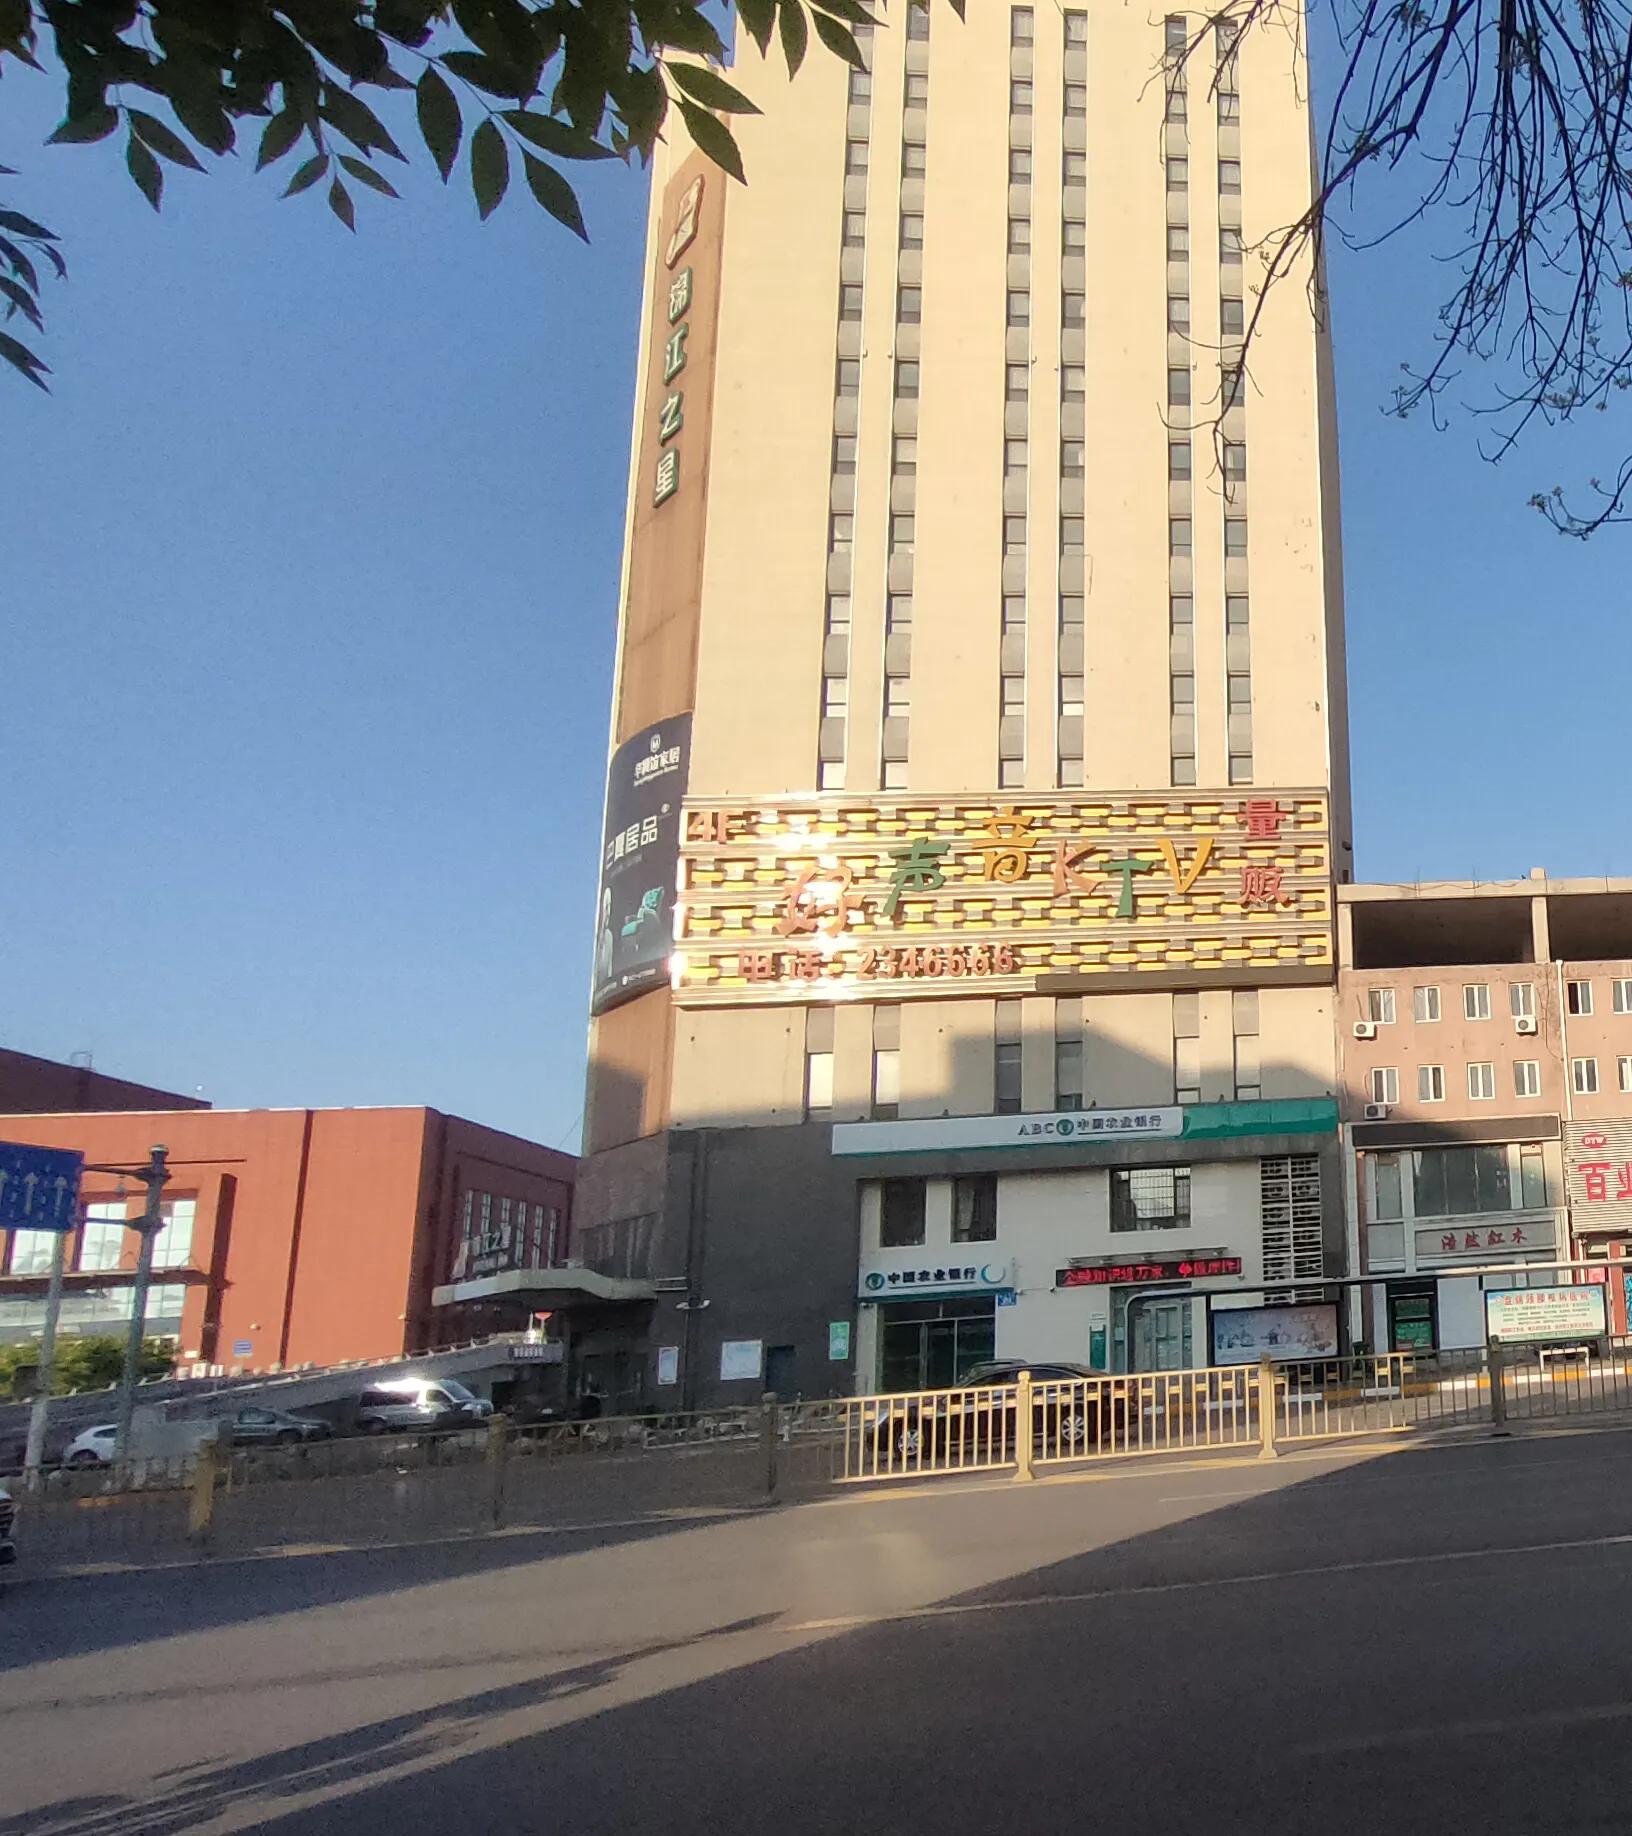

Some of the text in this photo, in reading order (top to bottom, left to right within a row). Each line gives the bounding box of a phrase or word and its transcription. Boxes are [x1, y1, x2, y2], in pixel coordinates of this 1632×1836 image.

[687, 809, 745, 845] 4F
[1237, 799, 1295, 908] 量贩
[1018, 1114, 1162, 1136] ABC 中国农业银行
[887, 1266, 977, 1284] 中国农业银行
